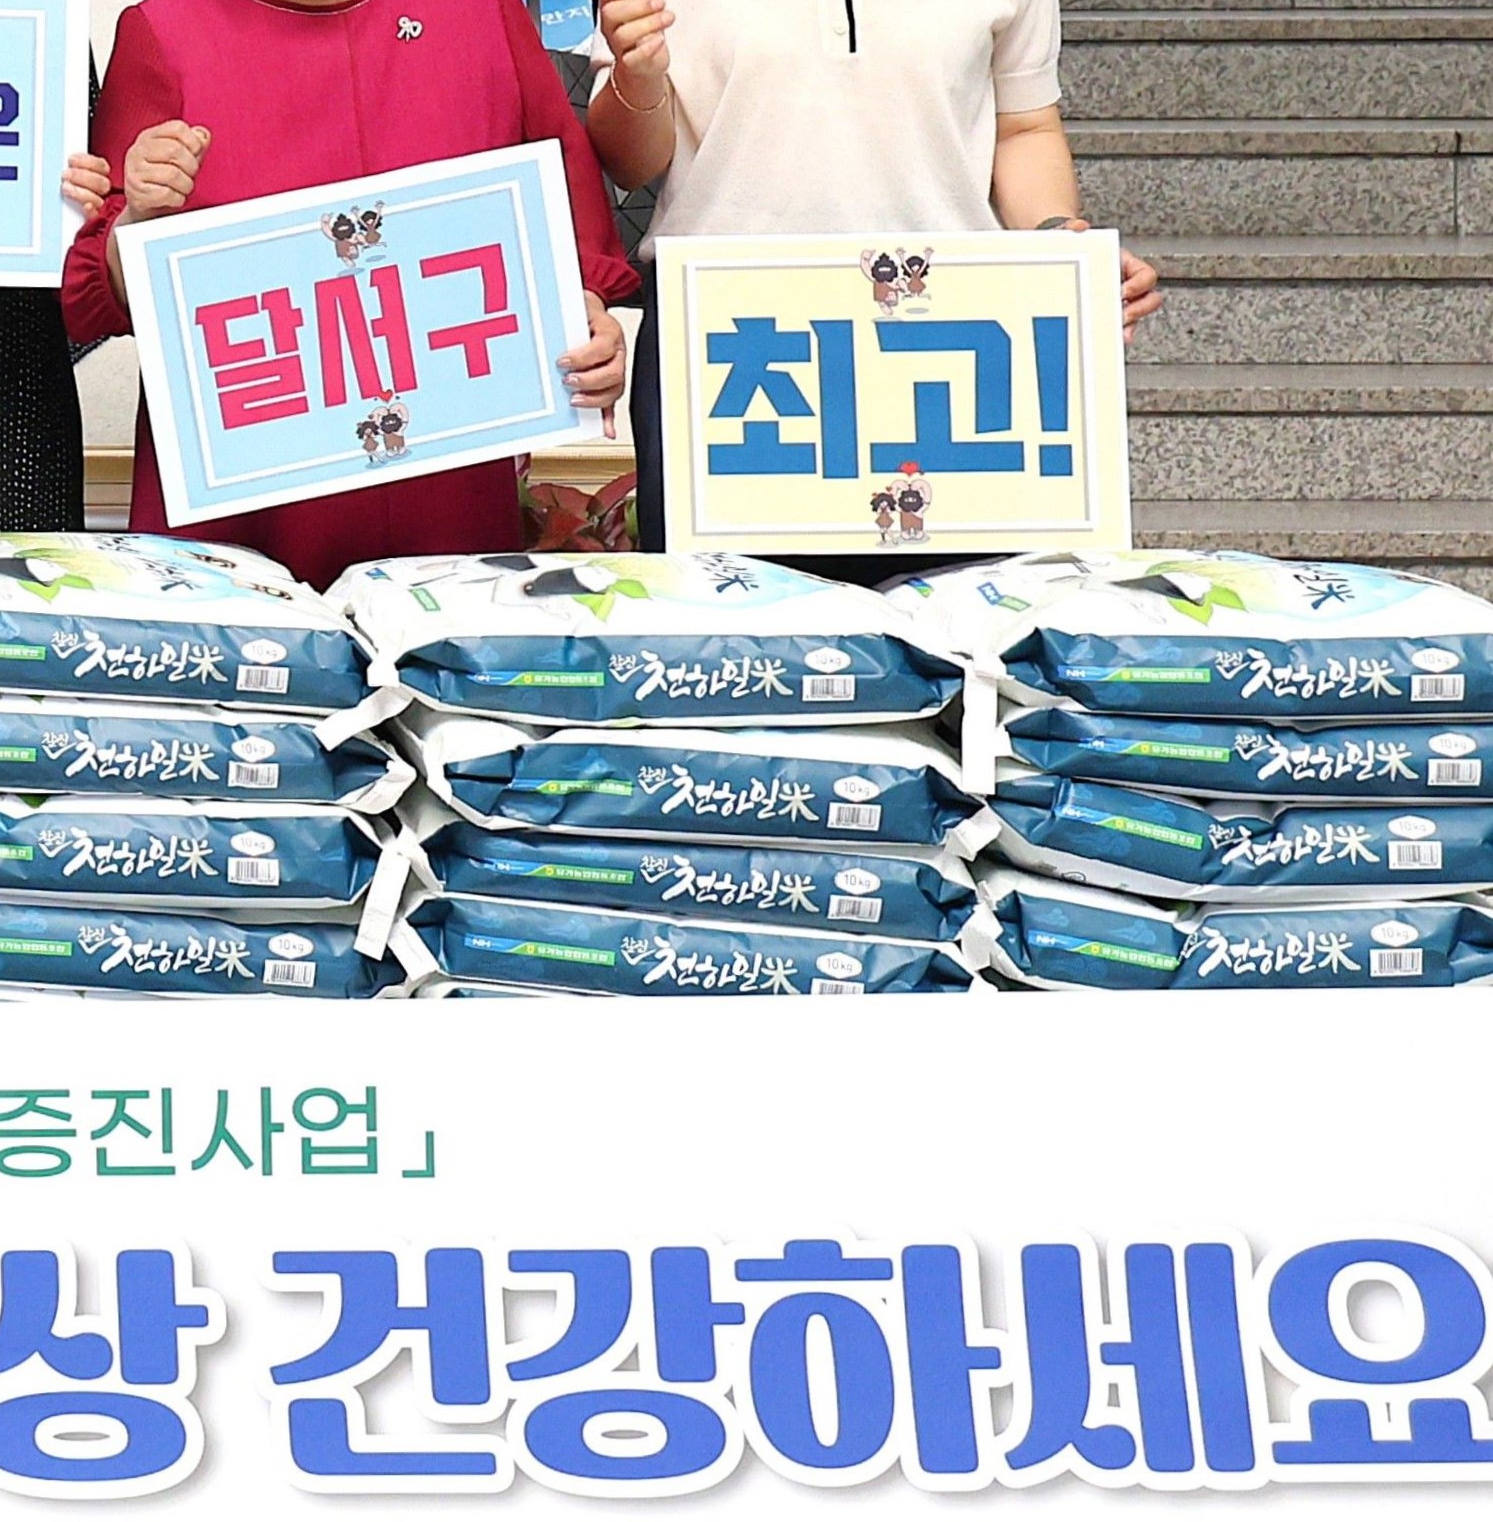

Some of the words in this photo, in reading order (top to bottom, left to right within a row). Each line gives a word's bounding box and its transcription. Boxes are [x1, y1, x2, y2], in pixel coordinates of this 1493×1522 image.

[195, 243, 520, 430] 달서구
[706, 316, 1074, 480] 최고!
[73, 630, 228, 684] 천하일米
[251, 645, 280, 659] 10kg
[635, 649, 793, 701] 천하일米
[813, 654, 843, 667] 10kg
[1241, 648, 1402, 699] 천하일米
[1422, 653, 1451, 666] 10kg
[66, 730, 219, 782] 천하일米
[241, 741, 268, 755] 10kg
[1257, 734, 1419, 781] 천하일米
[1439, 738, 1467, 751] 10kg
[661, 764, 819, 822] 천하일米
[842, 782, 872, 796] 10kg
[239, 837, 266, 852] 10kg
[1398, 822, 1427, 834] 10kg
[62, 828, 215, 877] 천하일米
[661, 854, 819, 912] 천하일米
[843, 872, 872, 888] 10kg
[101, 923, 255, 978] 천하일米
[276, 937, 306, 953] 10kg
[825, 955, 855, 972] 10kg
[1198, 926, 1361, 977] 천하일米
[270, 1240, 1493, 1478] 건강하세요
